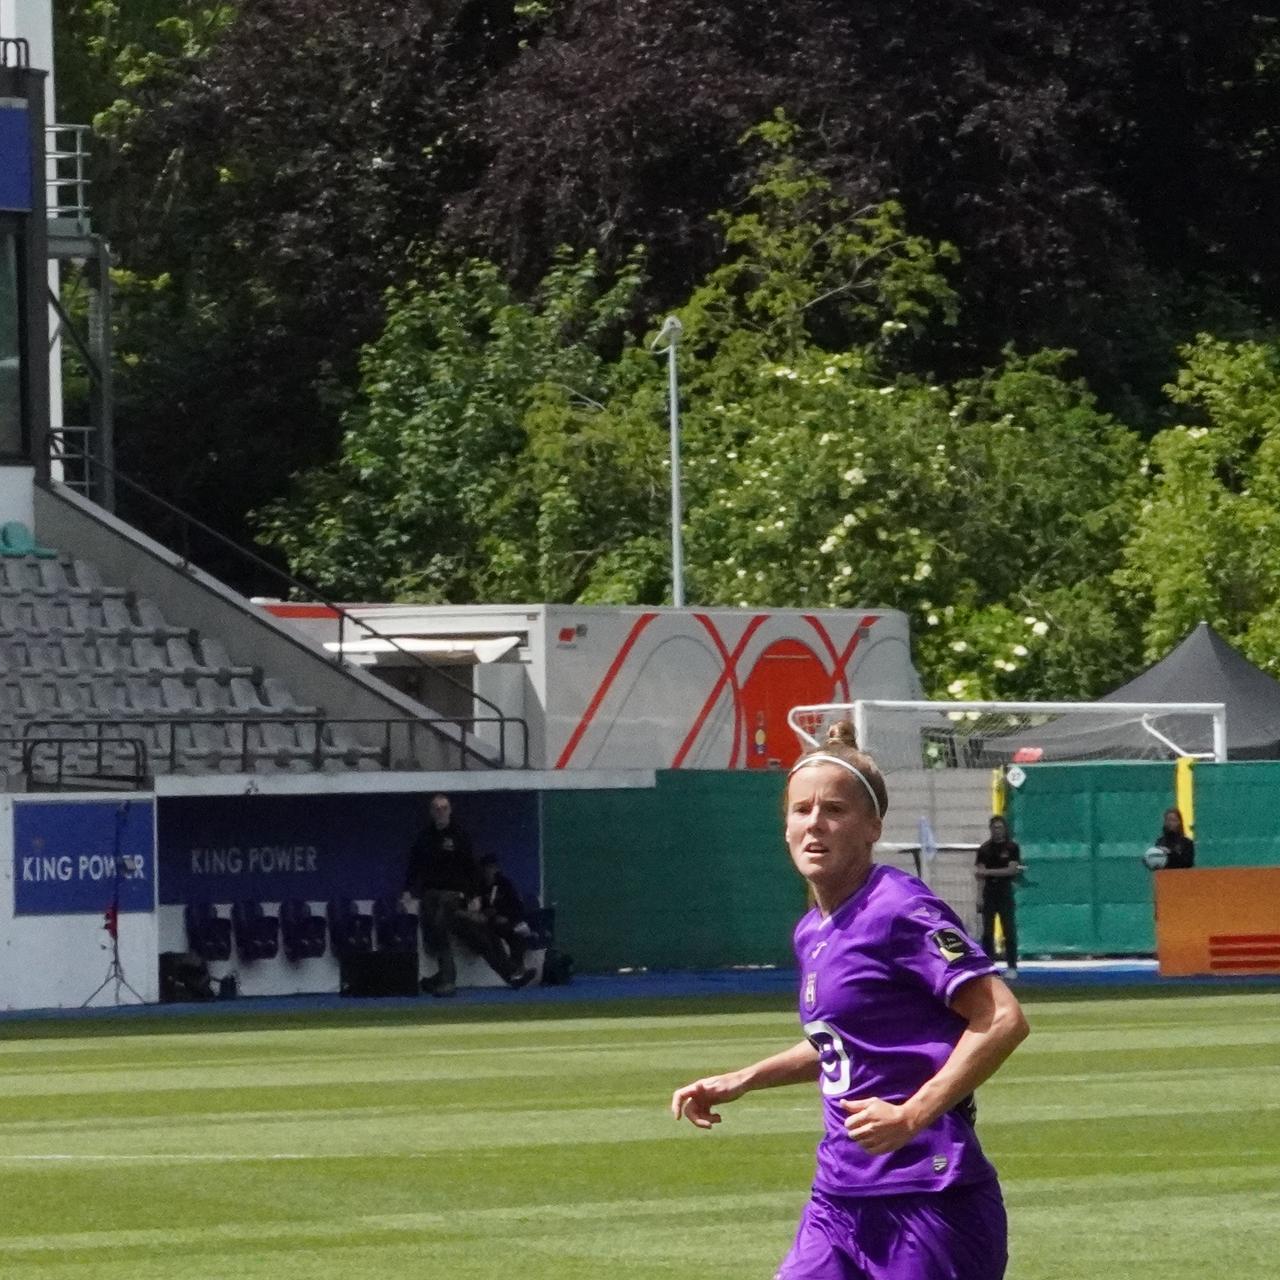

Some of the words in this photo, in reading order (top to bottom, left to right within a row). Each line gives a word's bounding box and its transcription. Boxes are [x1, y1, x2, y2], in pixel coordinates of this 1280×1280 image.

[22, 856, 73, 881] KING
[191, 847, 242, 874] KING
[248, 846, 318, 873] POWER
